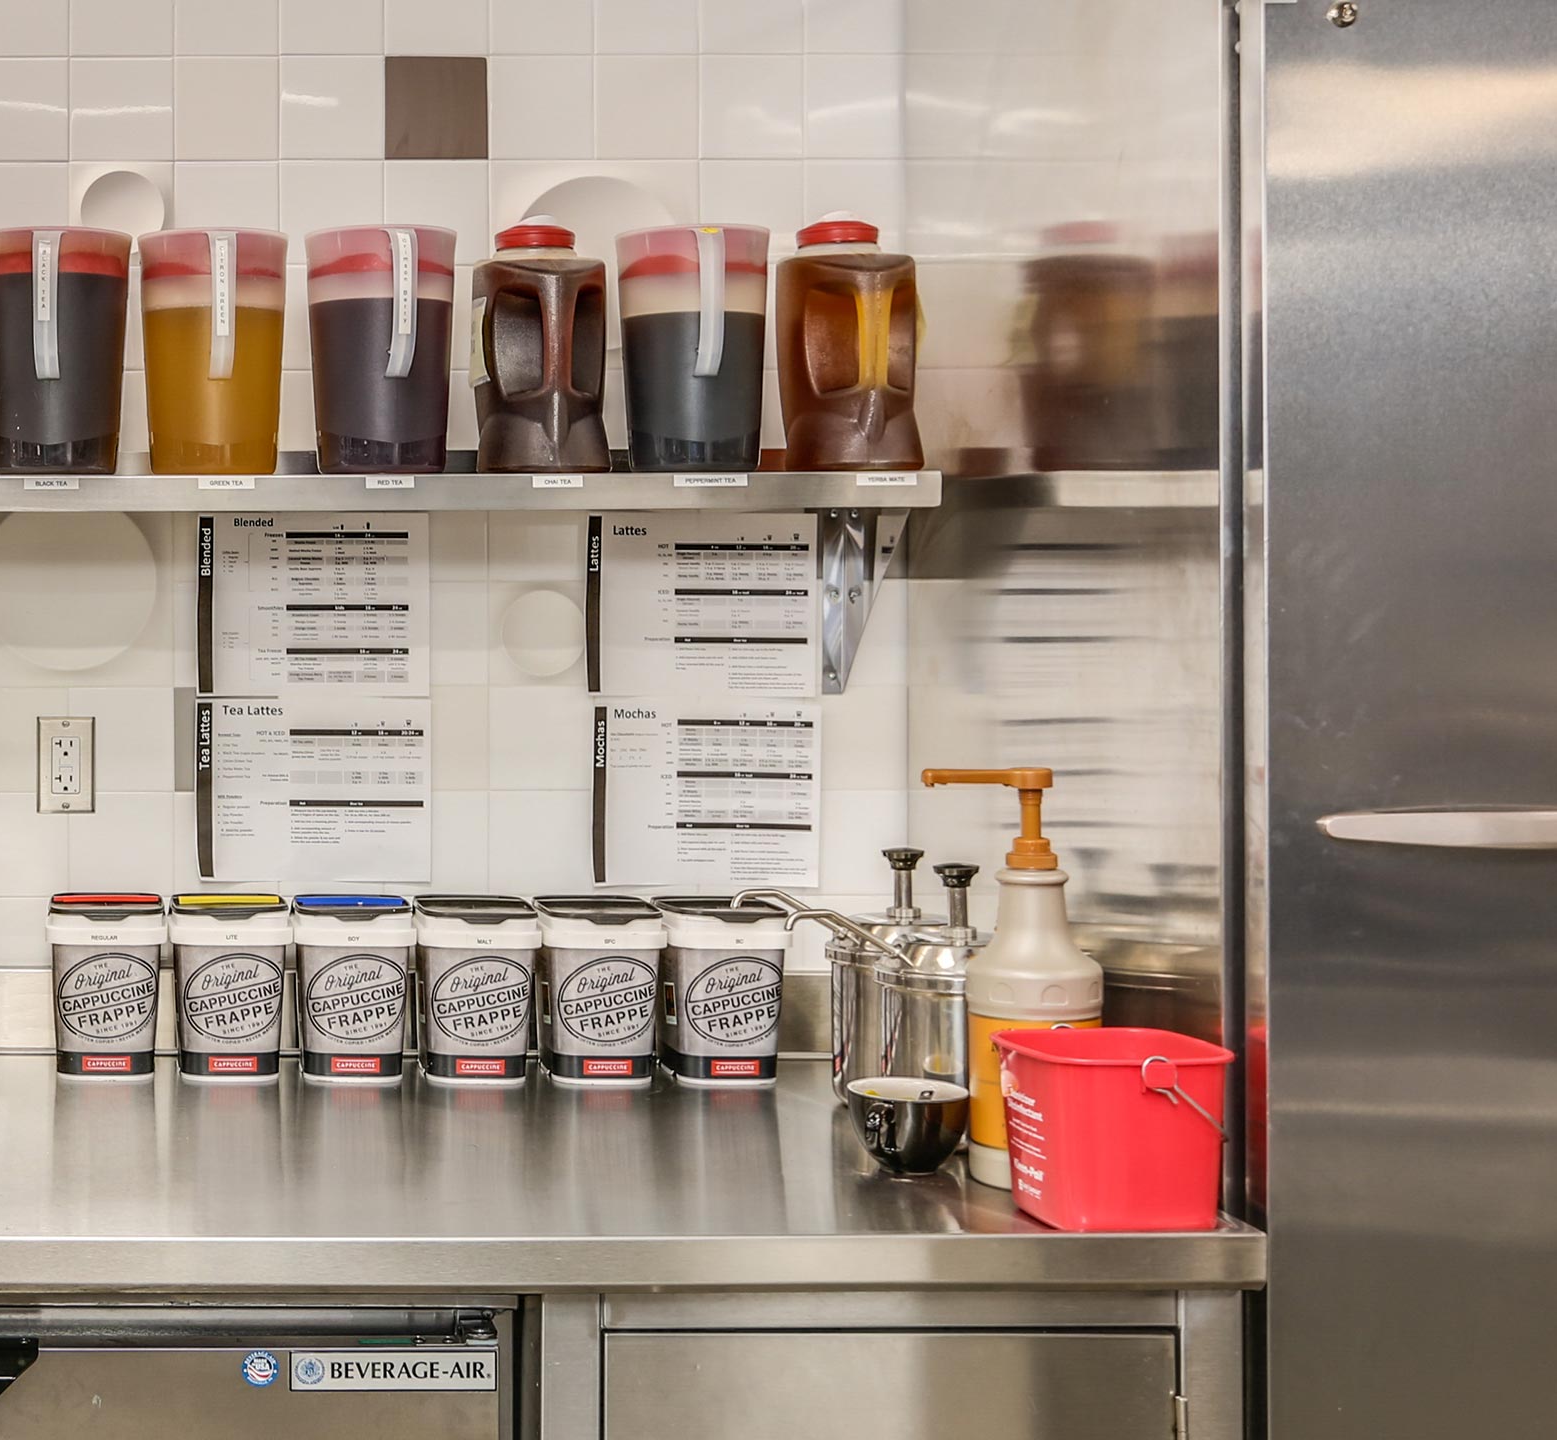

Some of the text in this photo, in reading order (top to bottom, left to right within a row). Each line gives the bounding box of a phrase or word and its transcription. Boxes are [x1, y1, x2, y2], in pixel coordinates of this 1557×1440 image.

[233, 517, 274, 528] Blended
[612, 525, 647, 536] Lattes
[200, 527, 211, 577] Blended
[589, 535, 600, 572] Lattes
[222, 705, 284, 716] Tea Lattes
[613, 708, 657, 719] Mochas
[198, 709, 211, 771] Lattes Tea
[595, 720, 606, 768] Mochas
[74, 963, 132, 990] Original
[93, 962, 108, 970] THE
[201, 964, 259, 991] Original
[221, 963, 235, 971] THE
[324, 965, 383, 991] Original
[470, 965, 484, 973] THE
[725, 966, 739, 974] THE
[450, 967, 509, 993] Original
[577, 967, 635, 994] Original
[705, 967, 763, 994] Original
[62, 980, 154, 1012] CAPPUCCINE
[188, 981, 281, 1013] CAPPUCCINE
[311, 982, 404, 1013] CAPPUCCINE
[436, 984, 529, 1015] CAPPUCCINE
[563, 984, 656, 1016] CAPPUCCINE
[691, 984, 782, 1016] CAPPUCCINE
[77, 1001, 148, 1029] FRAPPE
[204, 1001, 274, 1029] FRAPPE
[327, 1002, 397, 1030] FRAPPE
[452, 1005, 523, 1031] FRAPPE
[579, 1005, 649, 1032] FRAPPE
[707, 1005, 777, 1033] FRAPPE
[96, 1026, 118, 1035] SINCE
[222, 1026, 245, 1035] SINCE
[345, 1026, 368, 1036] SINCE
[470, 1028, 493, 1037] SINCE
[597, 1029, 620, 1038] SINCE
[725, 1029, 747, 1038] SINCE
[330, 1361, 485, 1379] BEVERAGE-AIR
